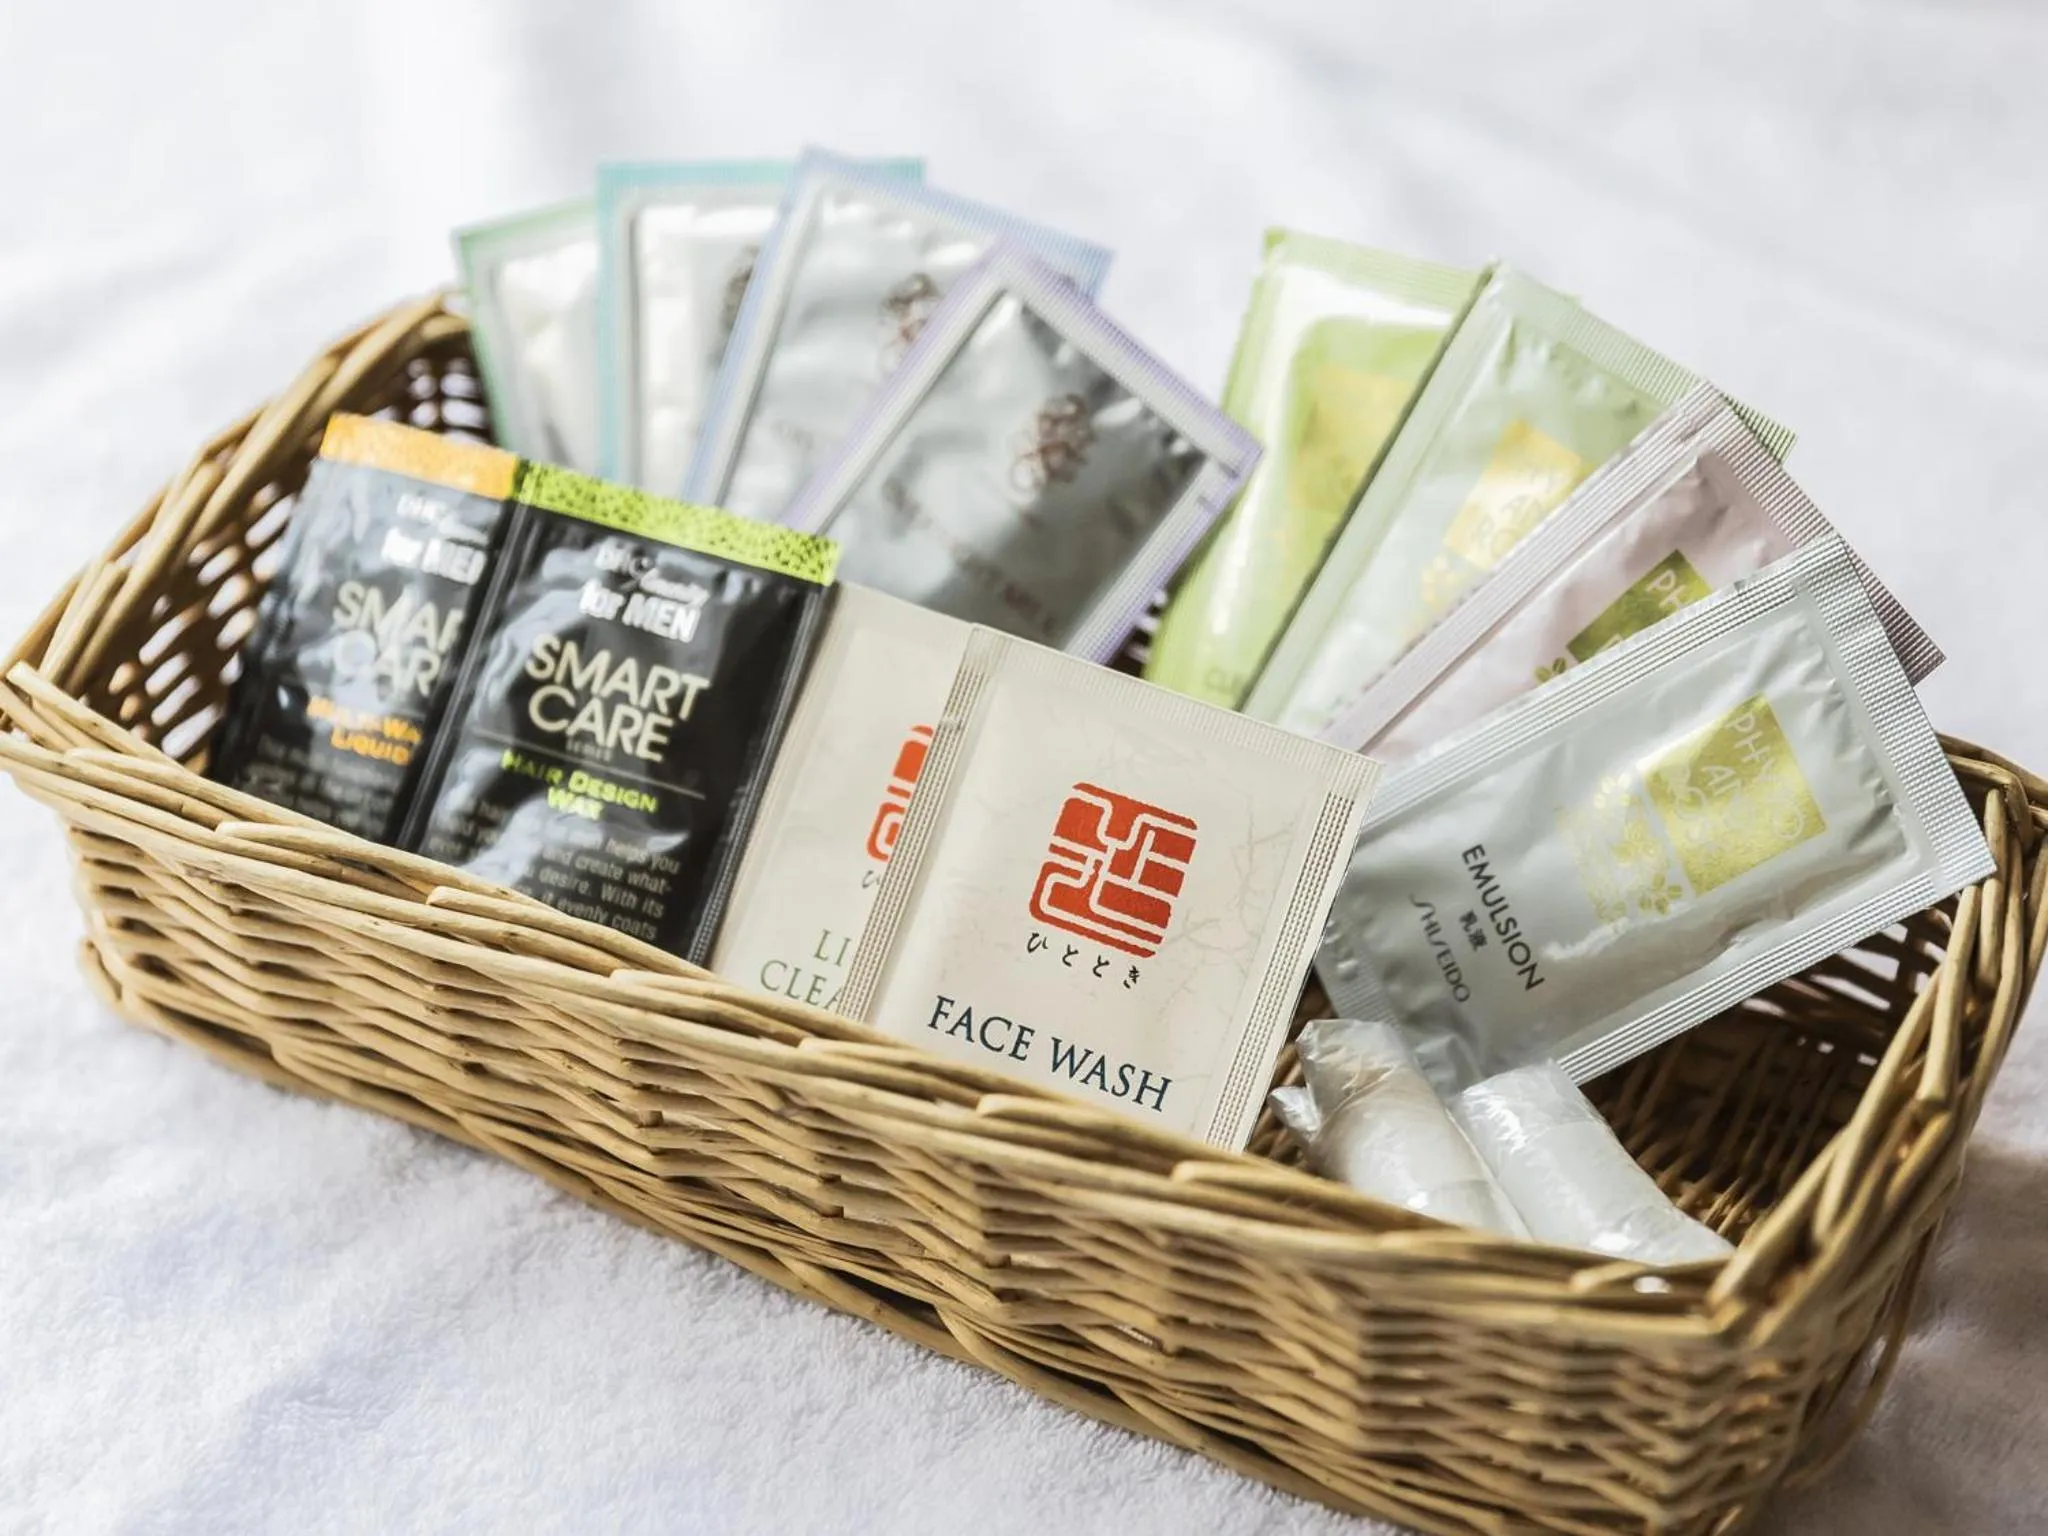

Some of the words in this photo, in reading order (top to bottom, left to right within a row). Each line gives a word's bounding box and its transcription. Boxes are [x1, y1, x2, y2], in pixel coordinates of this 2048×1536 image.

[621, 593, 702, 643] MEN
[525, 633, 712, 721] SMART
[529, 685, 676, 763] CARE
[567, 770, 659, 813] DESIGN
[573, 855, 624, 881] create
[650, 851, 681, 876] you
[601, 881, 639, 909] With
[642, 896, 665, 919] its
[1461, 844, 1546, 992] EMULSION
[612, 914, 660, 942] coats
[813, 928, 852, 967] LI
[1409, 892, 1471, 1003] SHISEIDO
[1026, 932, 1141, 990] ひととき
[927, 995, 1036, 1061] FACE
[1050, 1037, 1173, 1112] WASH
